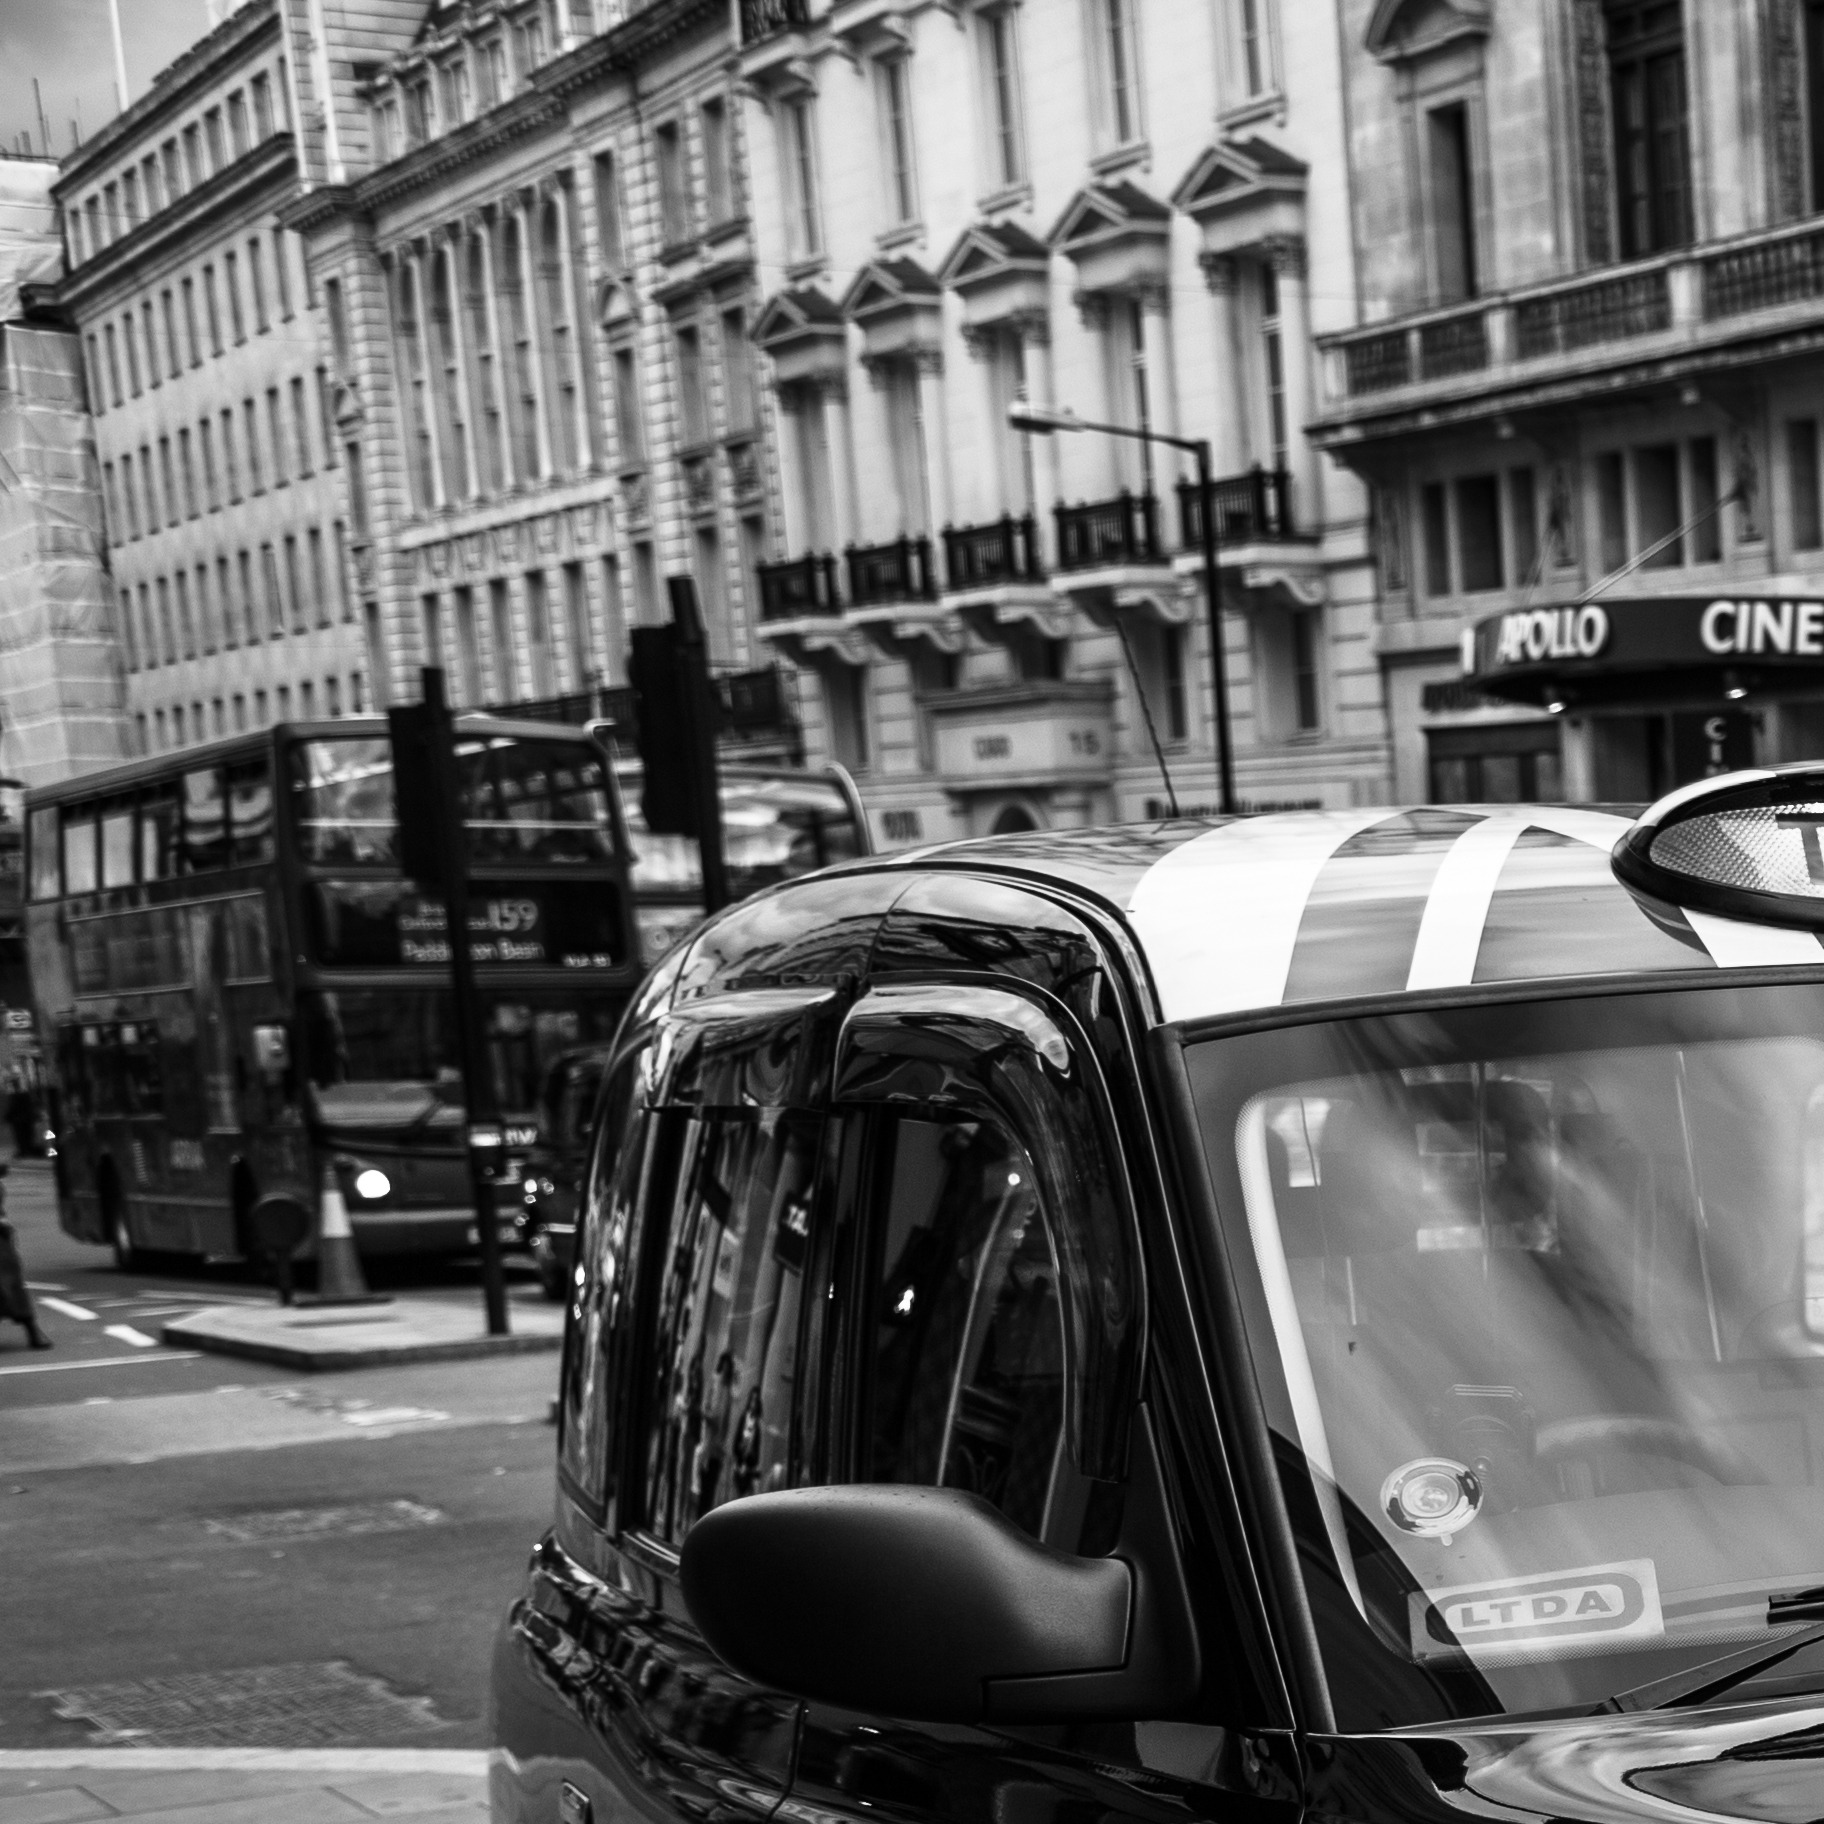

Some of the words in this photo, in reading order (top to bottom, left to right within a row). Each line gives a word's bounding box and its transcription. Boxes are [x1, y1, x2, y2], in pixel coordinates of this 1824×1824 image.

[1500, 604, 1610, 662] APOLLO
[487, 898, 539, 932] 159
[1461, 1590, 1613, 1628] LTDA
